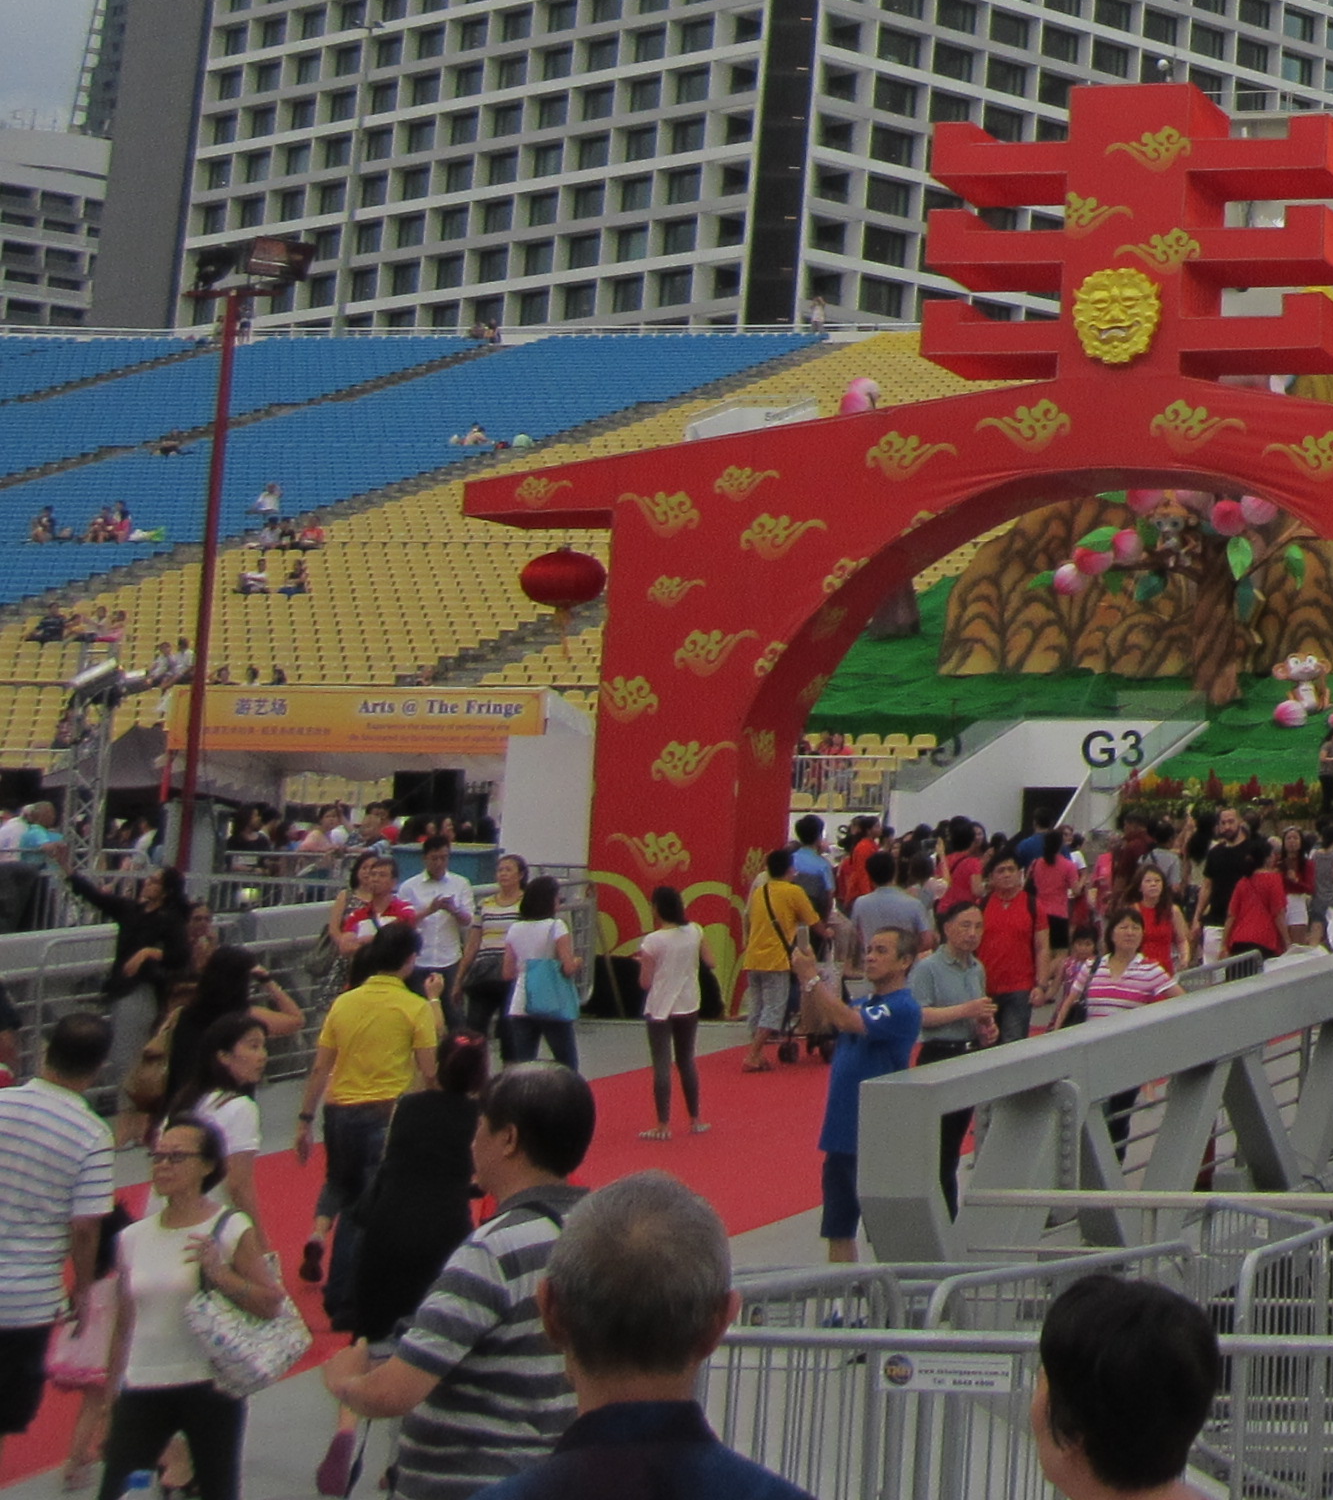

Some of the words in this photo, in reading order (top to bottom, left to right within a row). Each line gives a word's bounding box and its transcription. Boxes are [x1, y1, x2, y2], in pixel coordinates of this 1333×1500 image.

[358, 699, 395, 715] Arts
[402, 698, 419, 717] @
[426, 699, 460, 715] The
[465, 698, 524, 718] Fringe
[1081, 728, 1145, 769] G3
